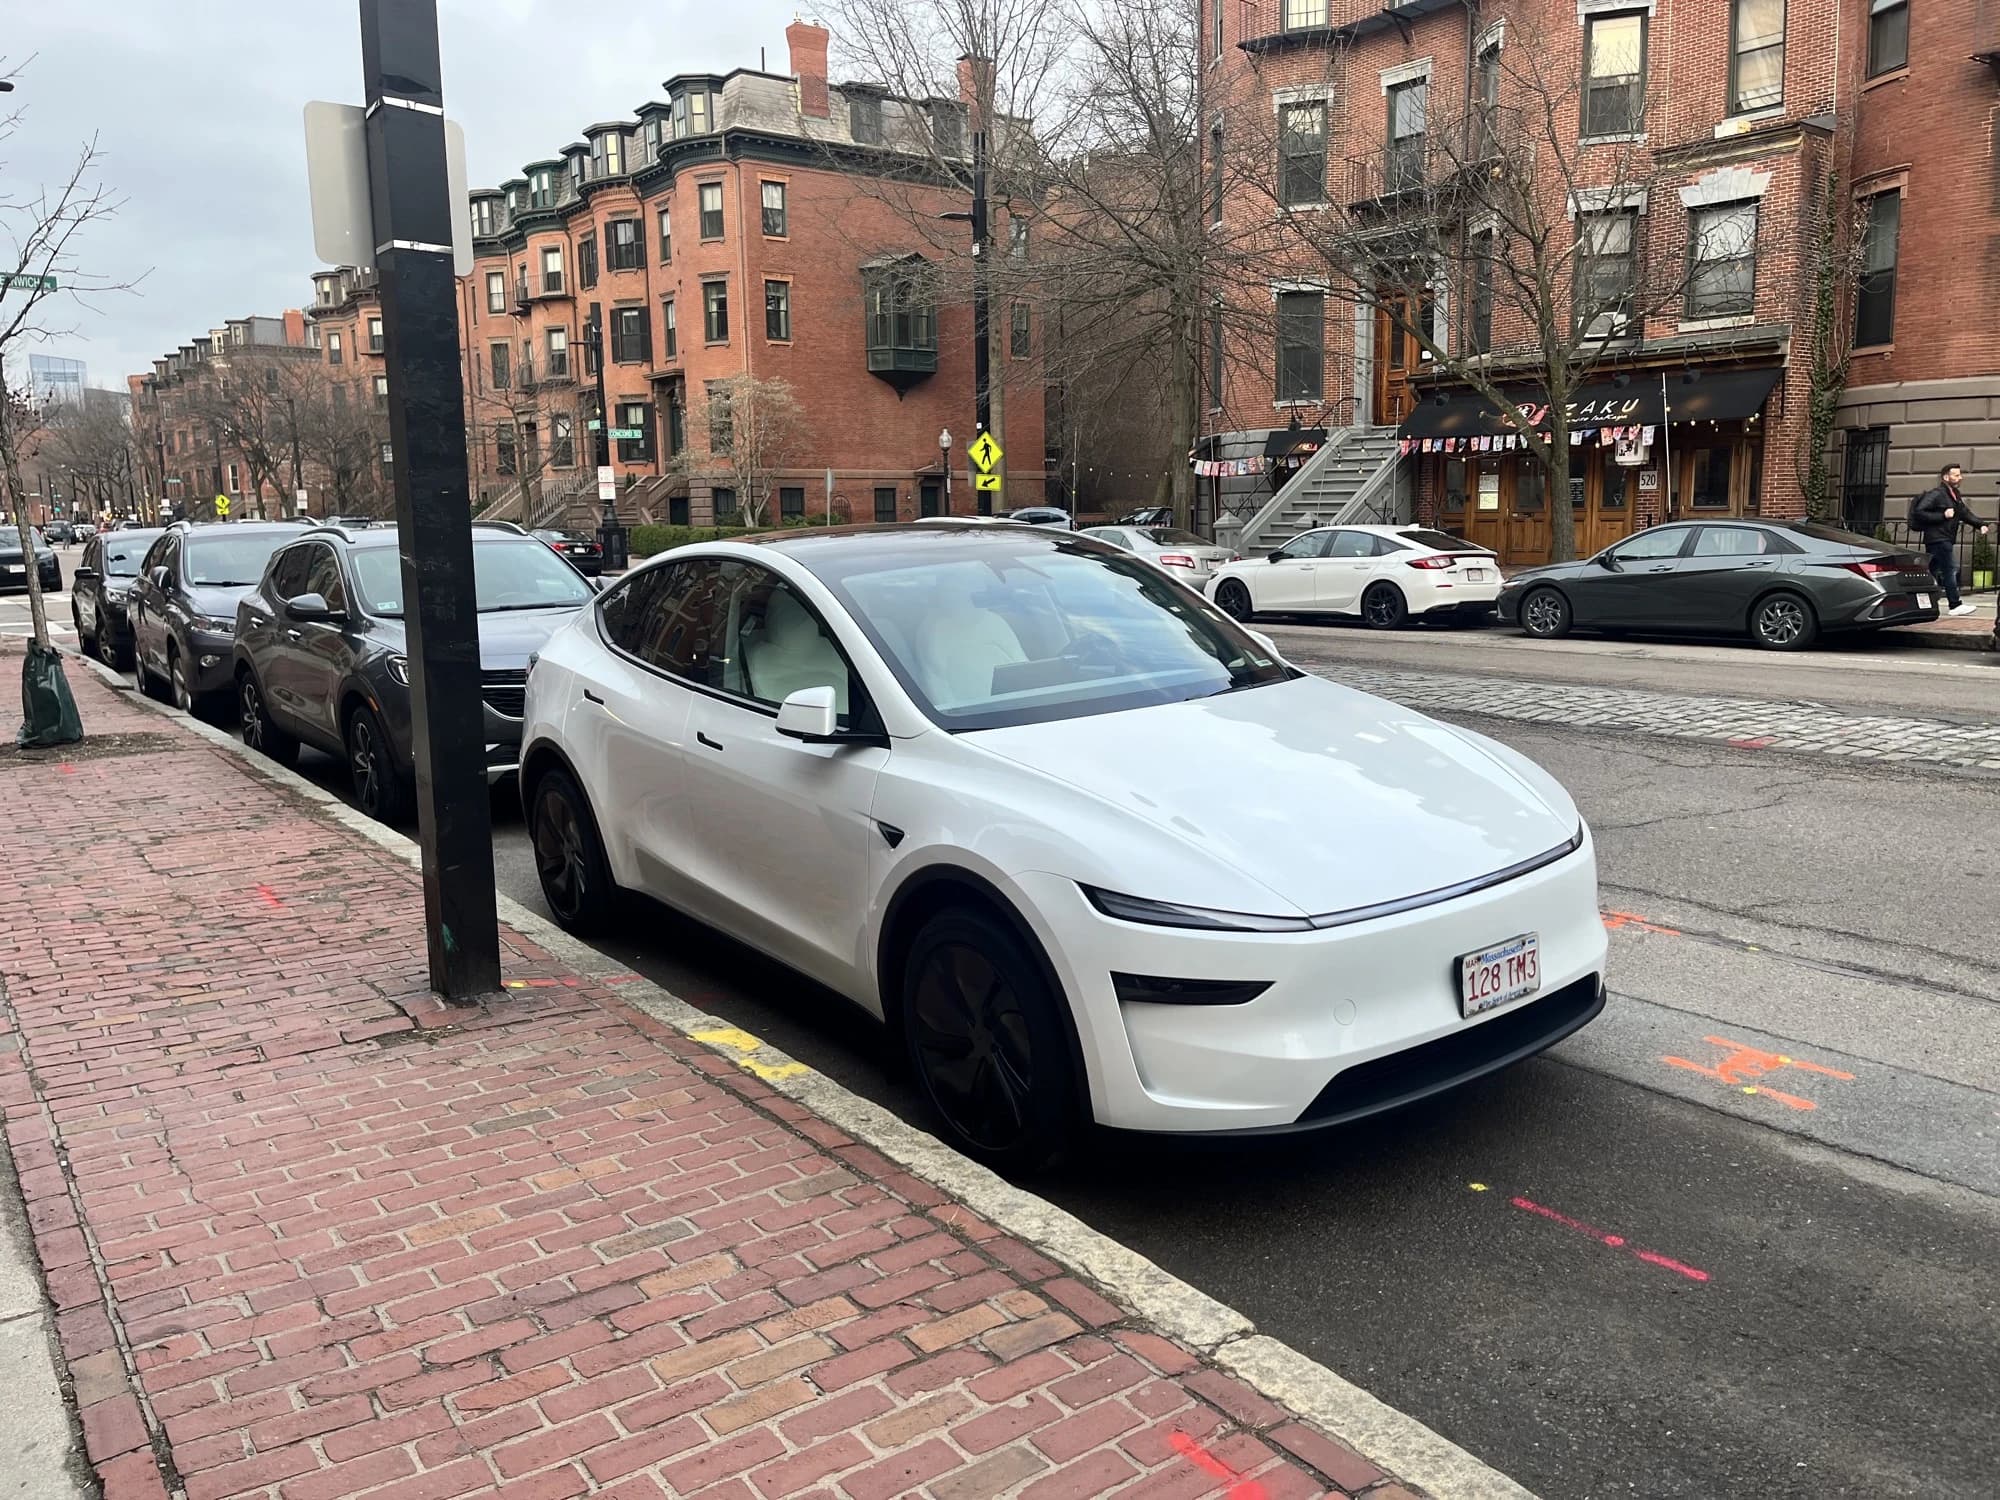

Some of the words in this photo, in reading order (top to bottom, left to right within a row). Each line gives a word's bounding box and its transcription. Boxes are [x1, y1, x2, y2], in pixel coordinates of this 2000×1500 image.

[0, 274, 41, 288] ENWICH
[1640, 474, 1656, 486] 520
[1468, 963, 1501, 1002] 128
[1506, 949, 1536, 987] TM3
